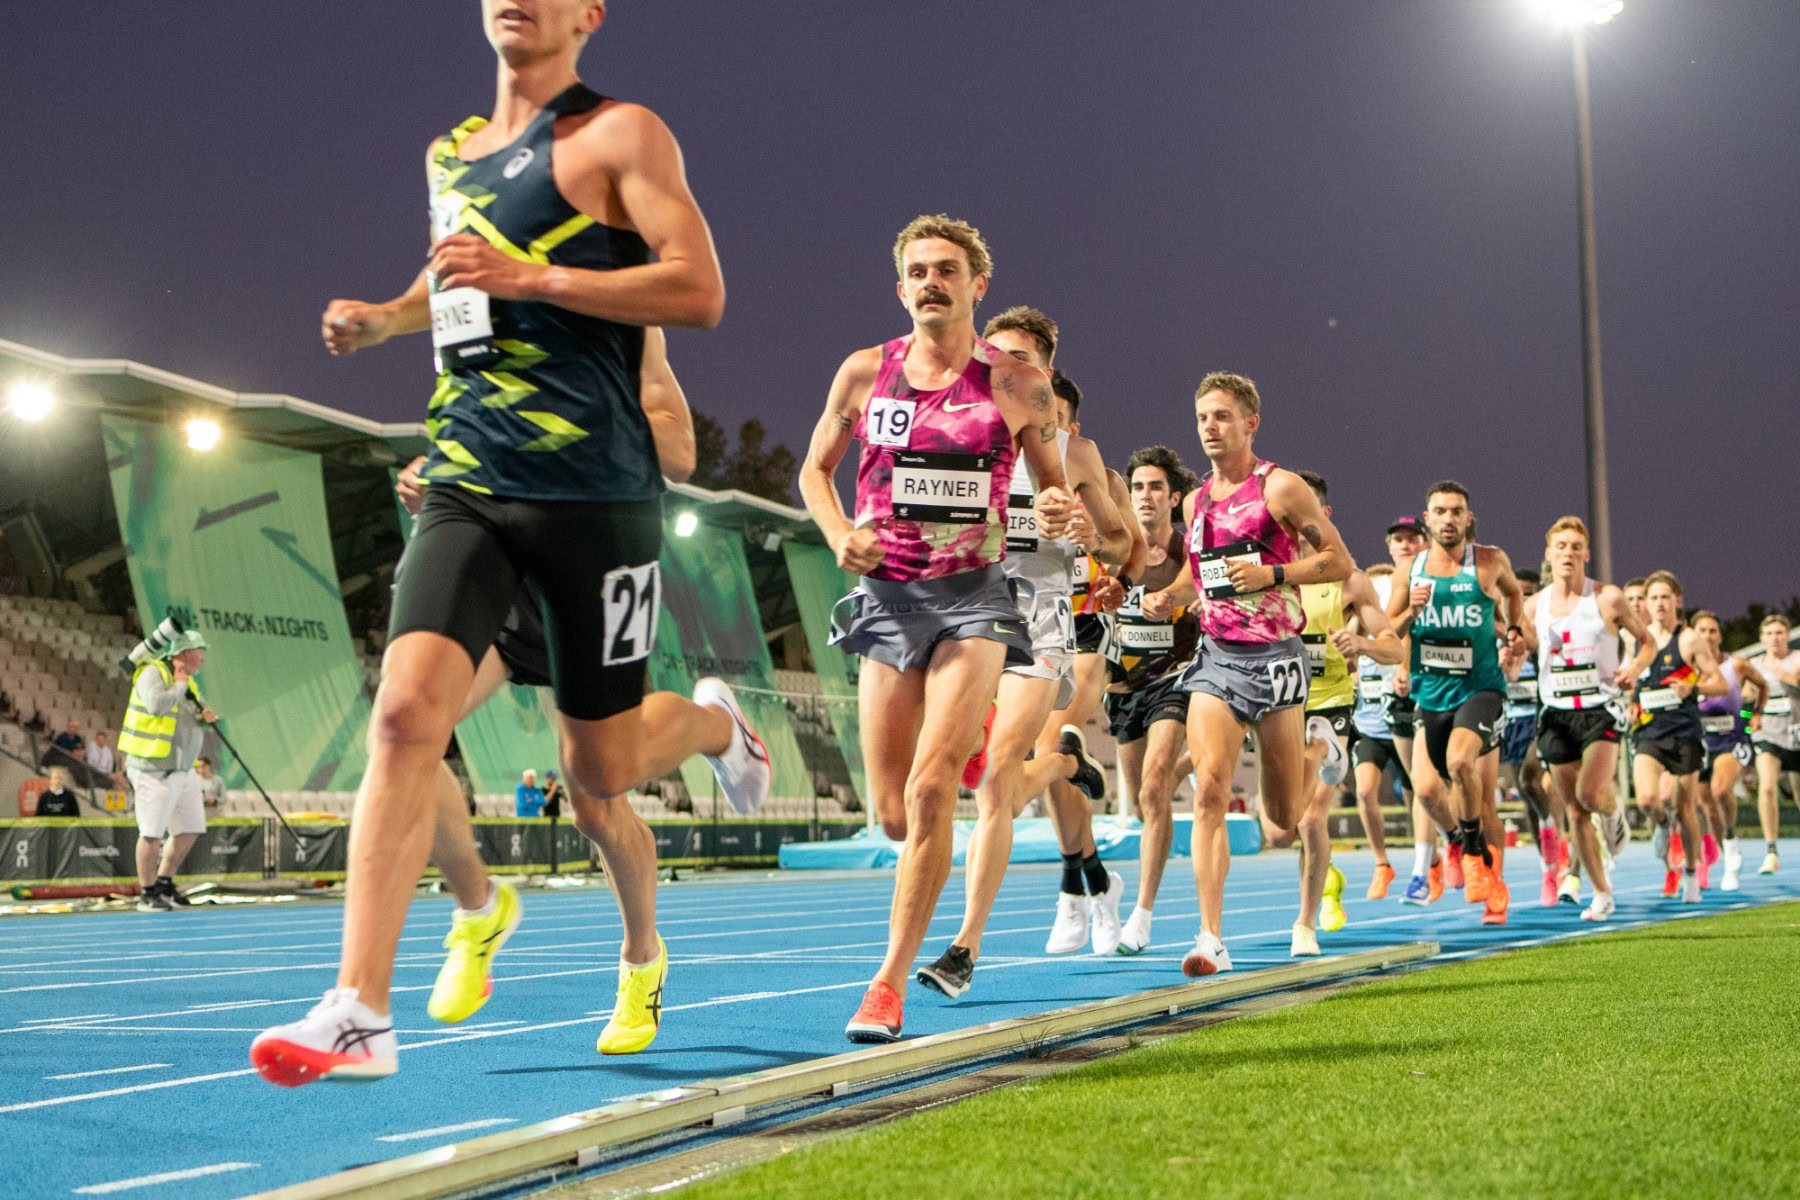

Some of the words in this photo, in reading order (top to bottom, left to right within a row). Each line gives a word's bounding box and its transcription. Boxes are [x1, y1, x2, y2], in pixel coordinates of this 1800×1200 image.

[432, 301, 473, 331] EYNE
[873, 407, 910, 437] 19
[903, 477, 979, 498] RAYNER
[609, 566, 655, 661] 21
[1425, 650, 1466, 664] CANALA
[1273, 660, 1305, 708] 22
[1555, 674, 1593, 687] LITTLE
